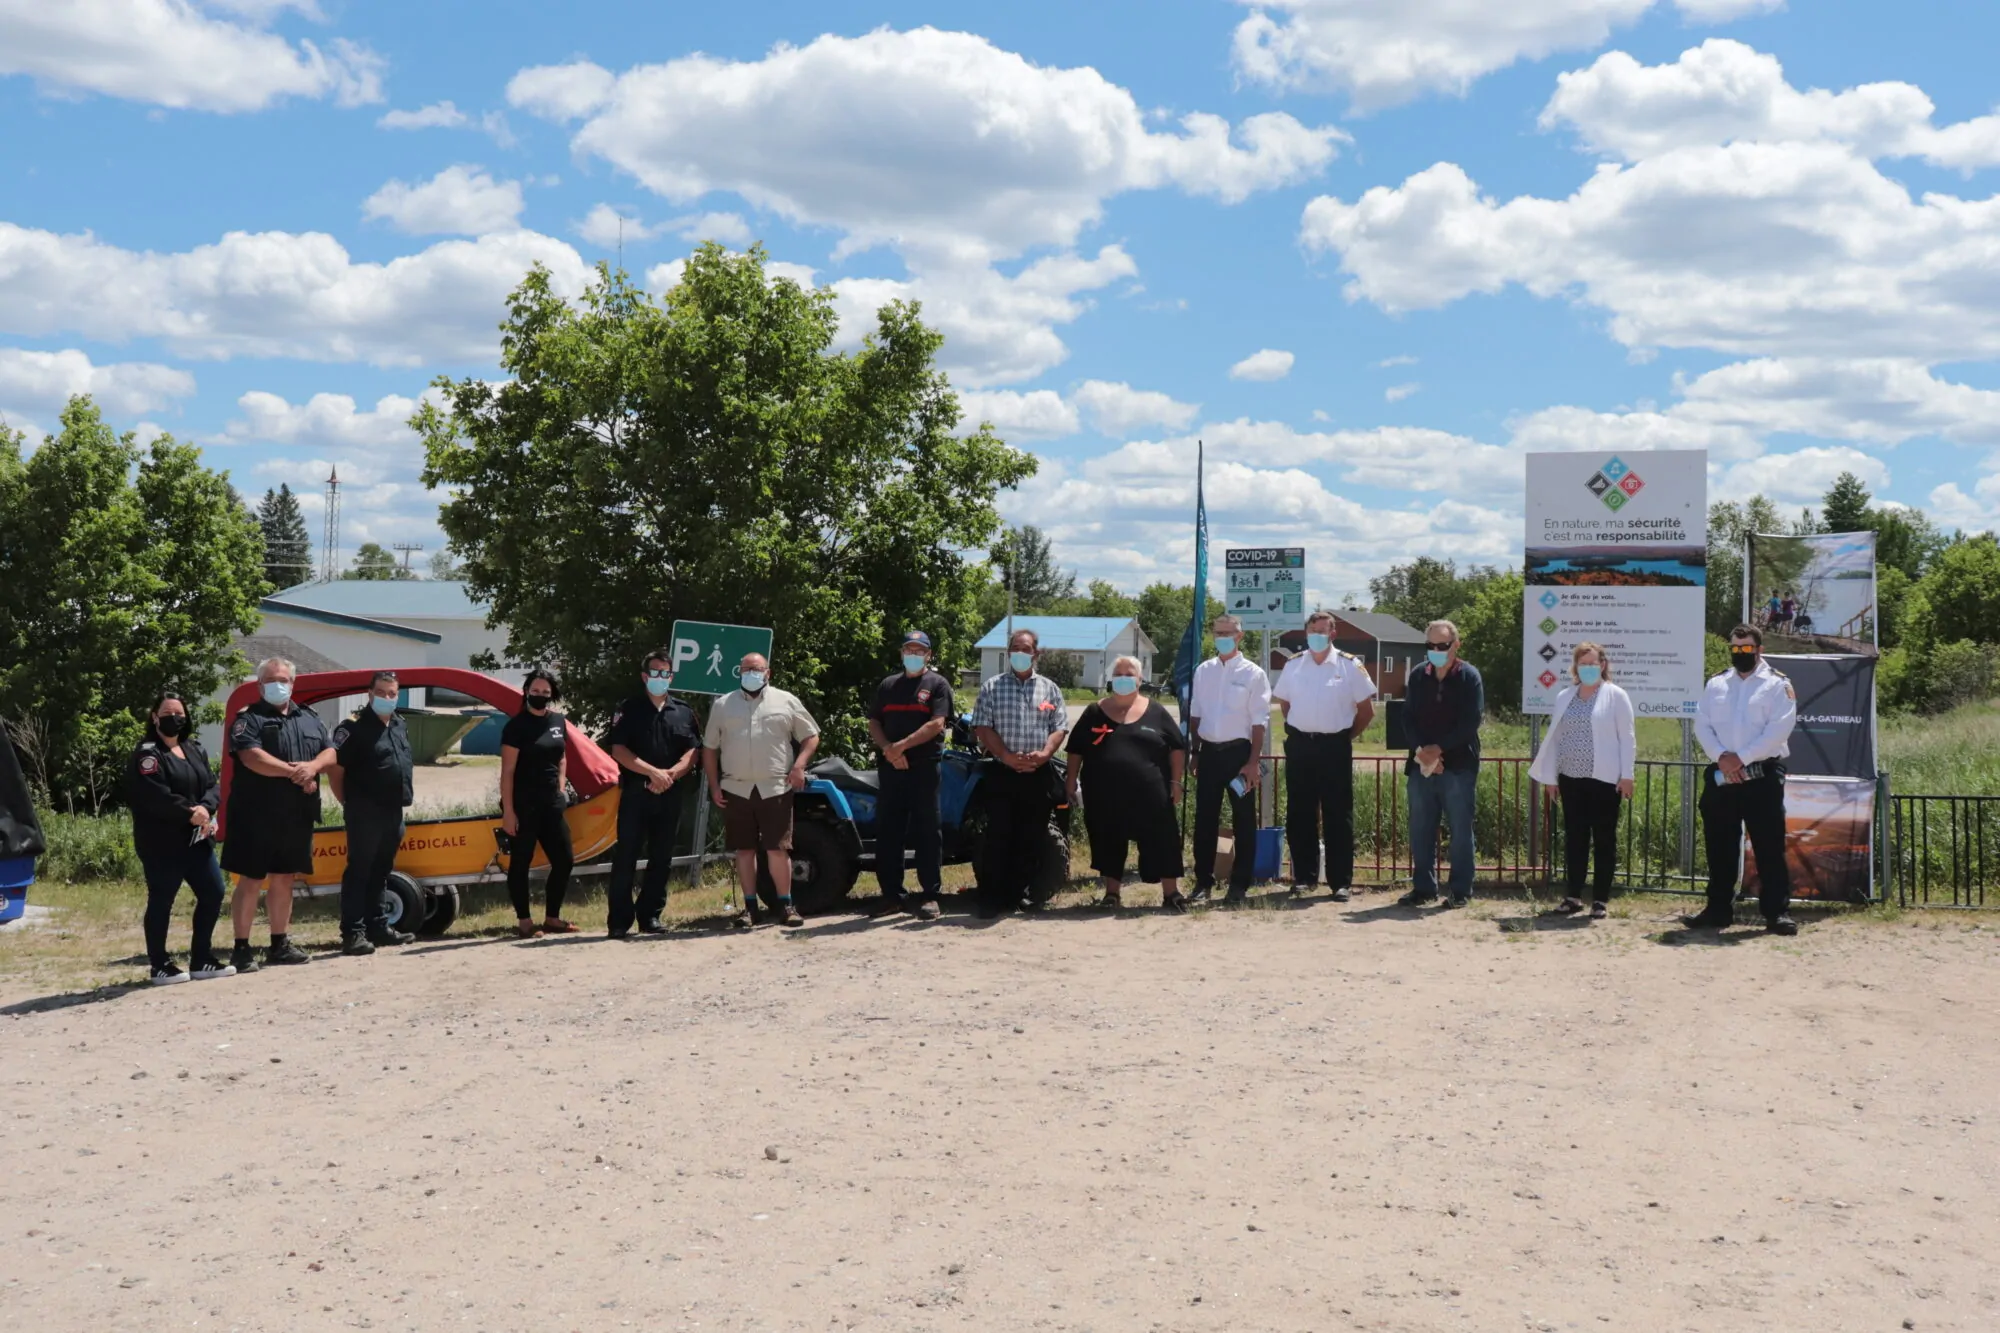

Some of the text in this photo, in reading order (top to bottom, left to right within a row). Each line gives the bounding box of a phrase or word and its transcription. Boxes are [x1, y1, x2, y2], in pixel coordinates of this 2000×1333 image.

[1544, 517, 1681, 530] En nature, ma sécurité
[1544, 530, 1686, 543] c'est ma responsabilité
[1227, 550, 1277, 561] COVID-19
[672, 638, 700, 673] P
[1638, 702, 1681, 714] Québec
[399, 835, 467, 852] MÉDICALE
